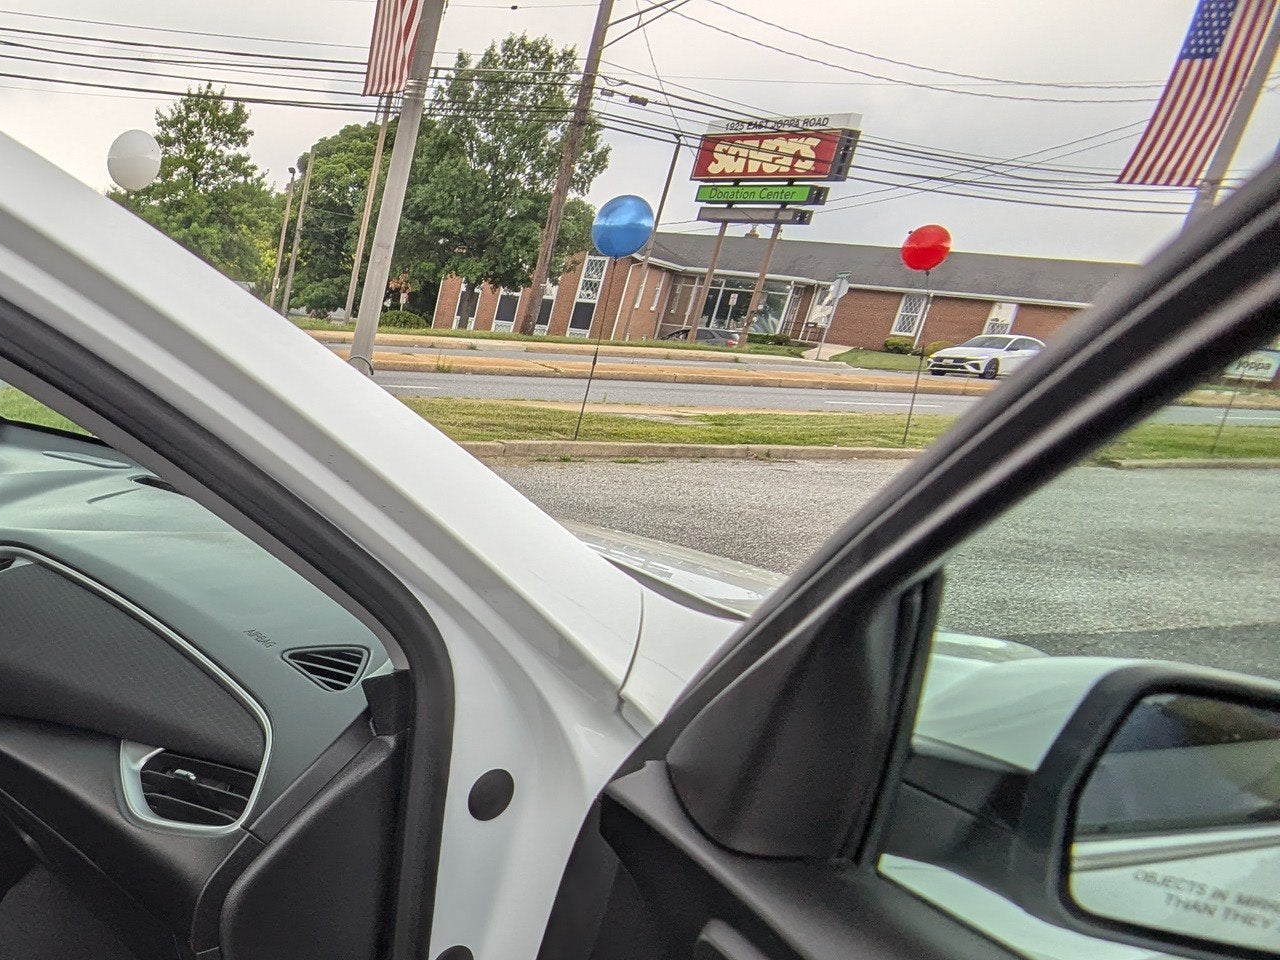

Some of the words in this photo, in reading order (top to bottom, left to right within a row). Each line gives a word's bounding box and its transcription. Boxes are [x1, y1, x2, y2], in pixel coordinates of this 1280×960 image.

[725, 122, 744, 131] 1925
[802, 117, 829, 127] ROAD
[709, 188, 755, 200] Donation
[758, 188, 796, 200] Center
